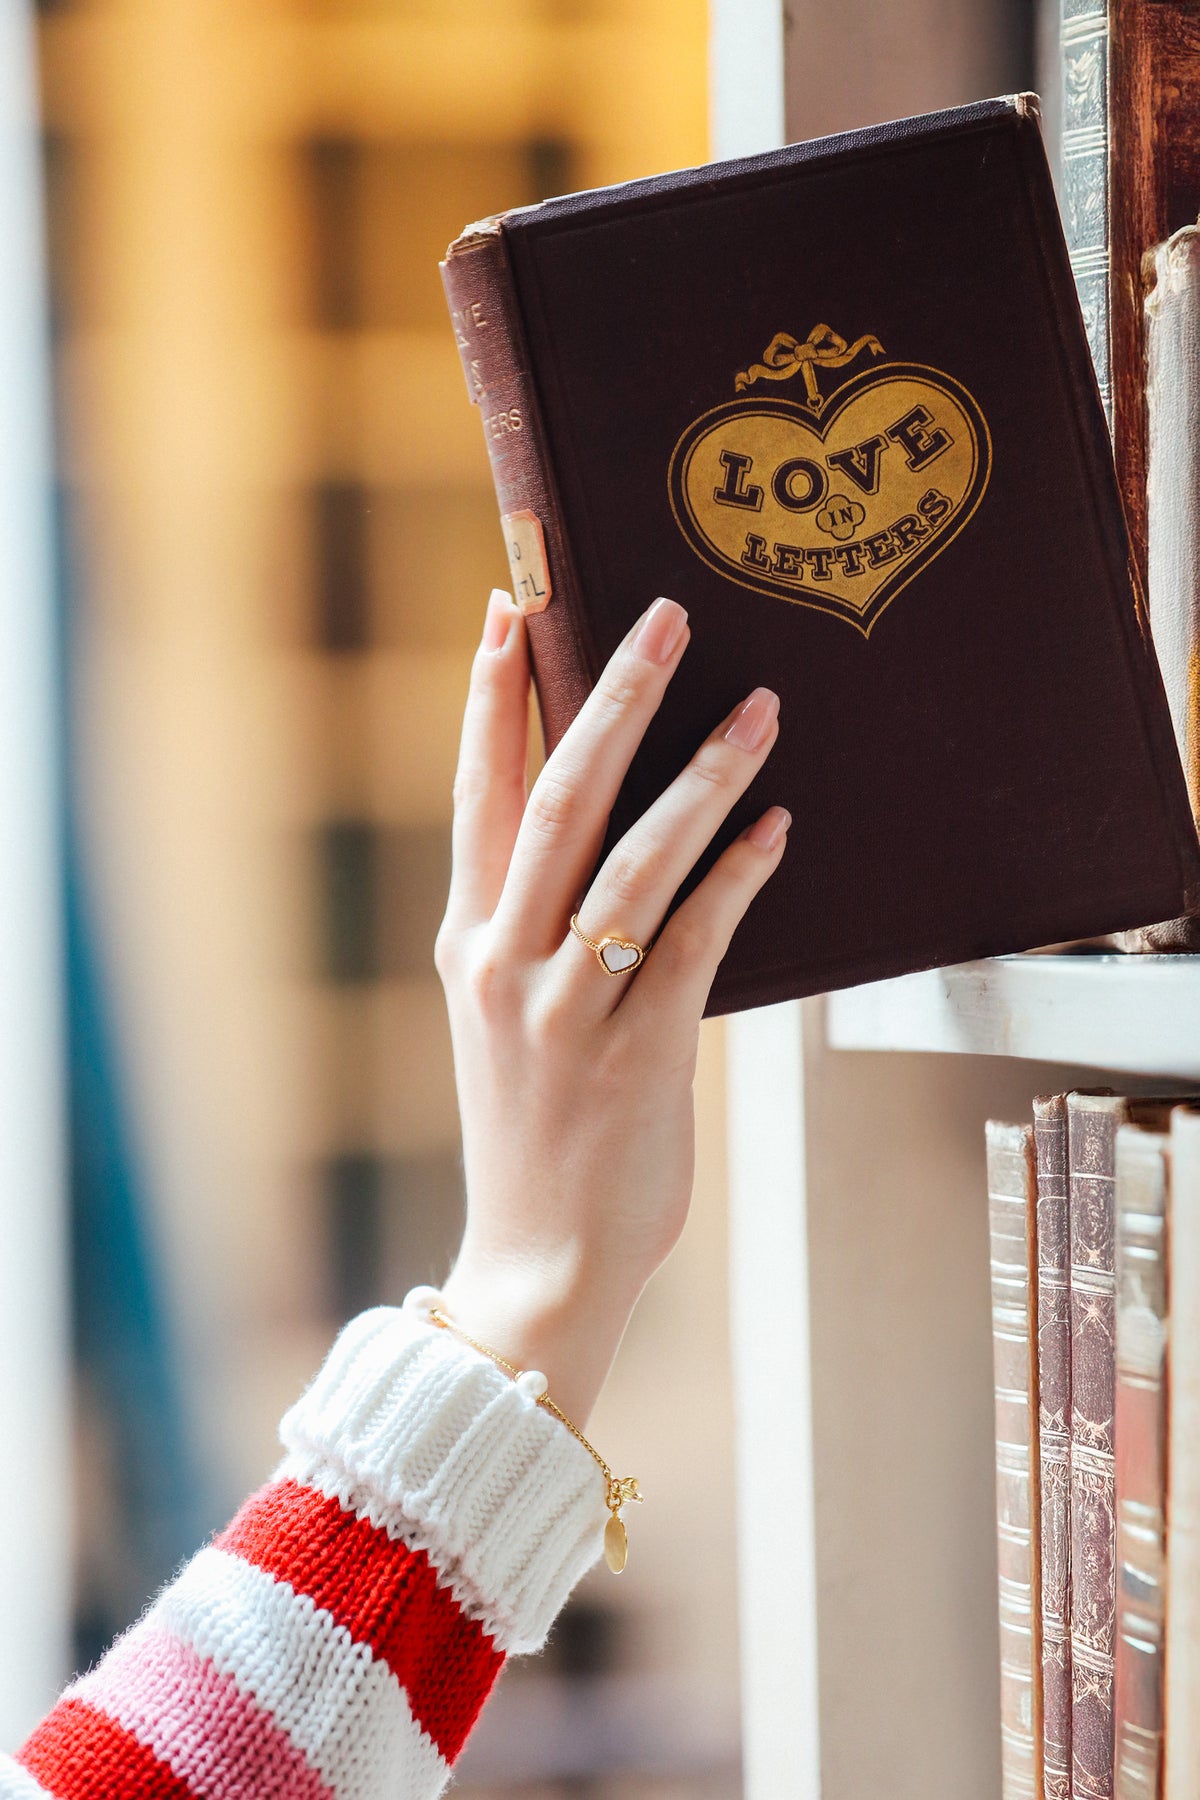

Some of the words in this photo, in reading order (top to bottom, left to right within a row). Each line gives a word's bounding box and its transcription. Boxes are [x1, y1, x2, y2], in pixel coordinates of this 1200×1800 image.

[713, 404, 955, 513] LOVE
[741, 488, 953, 581] LETTERS
[828, 506, 854, 527] IN
